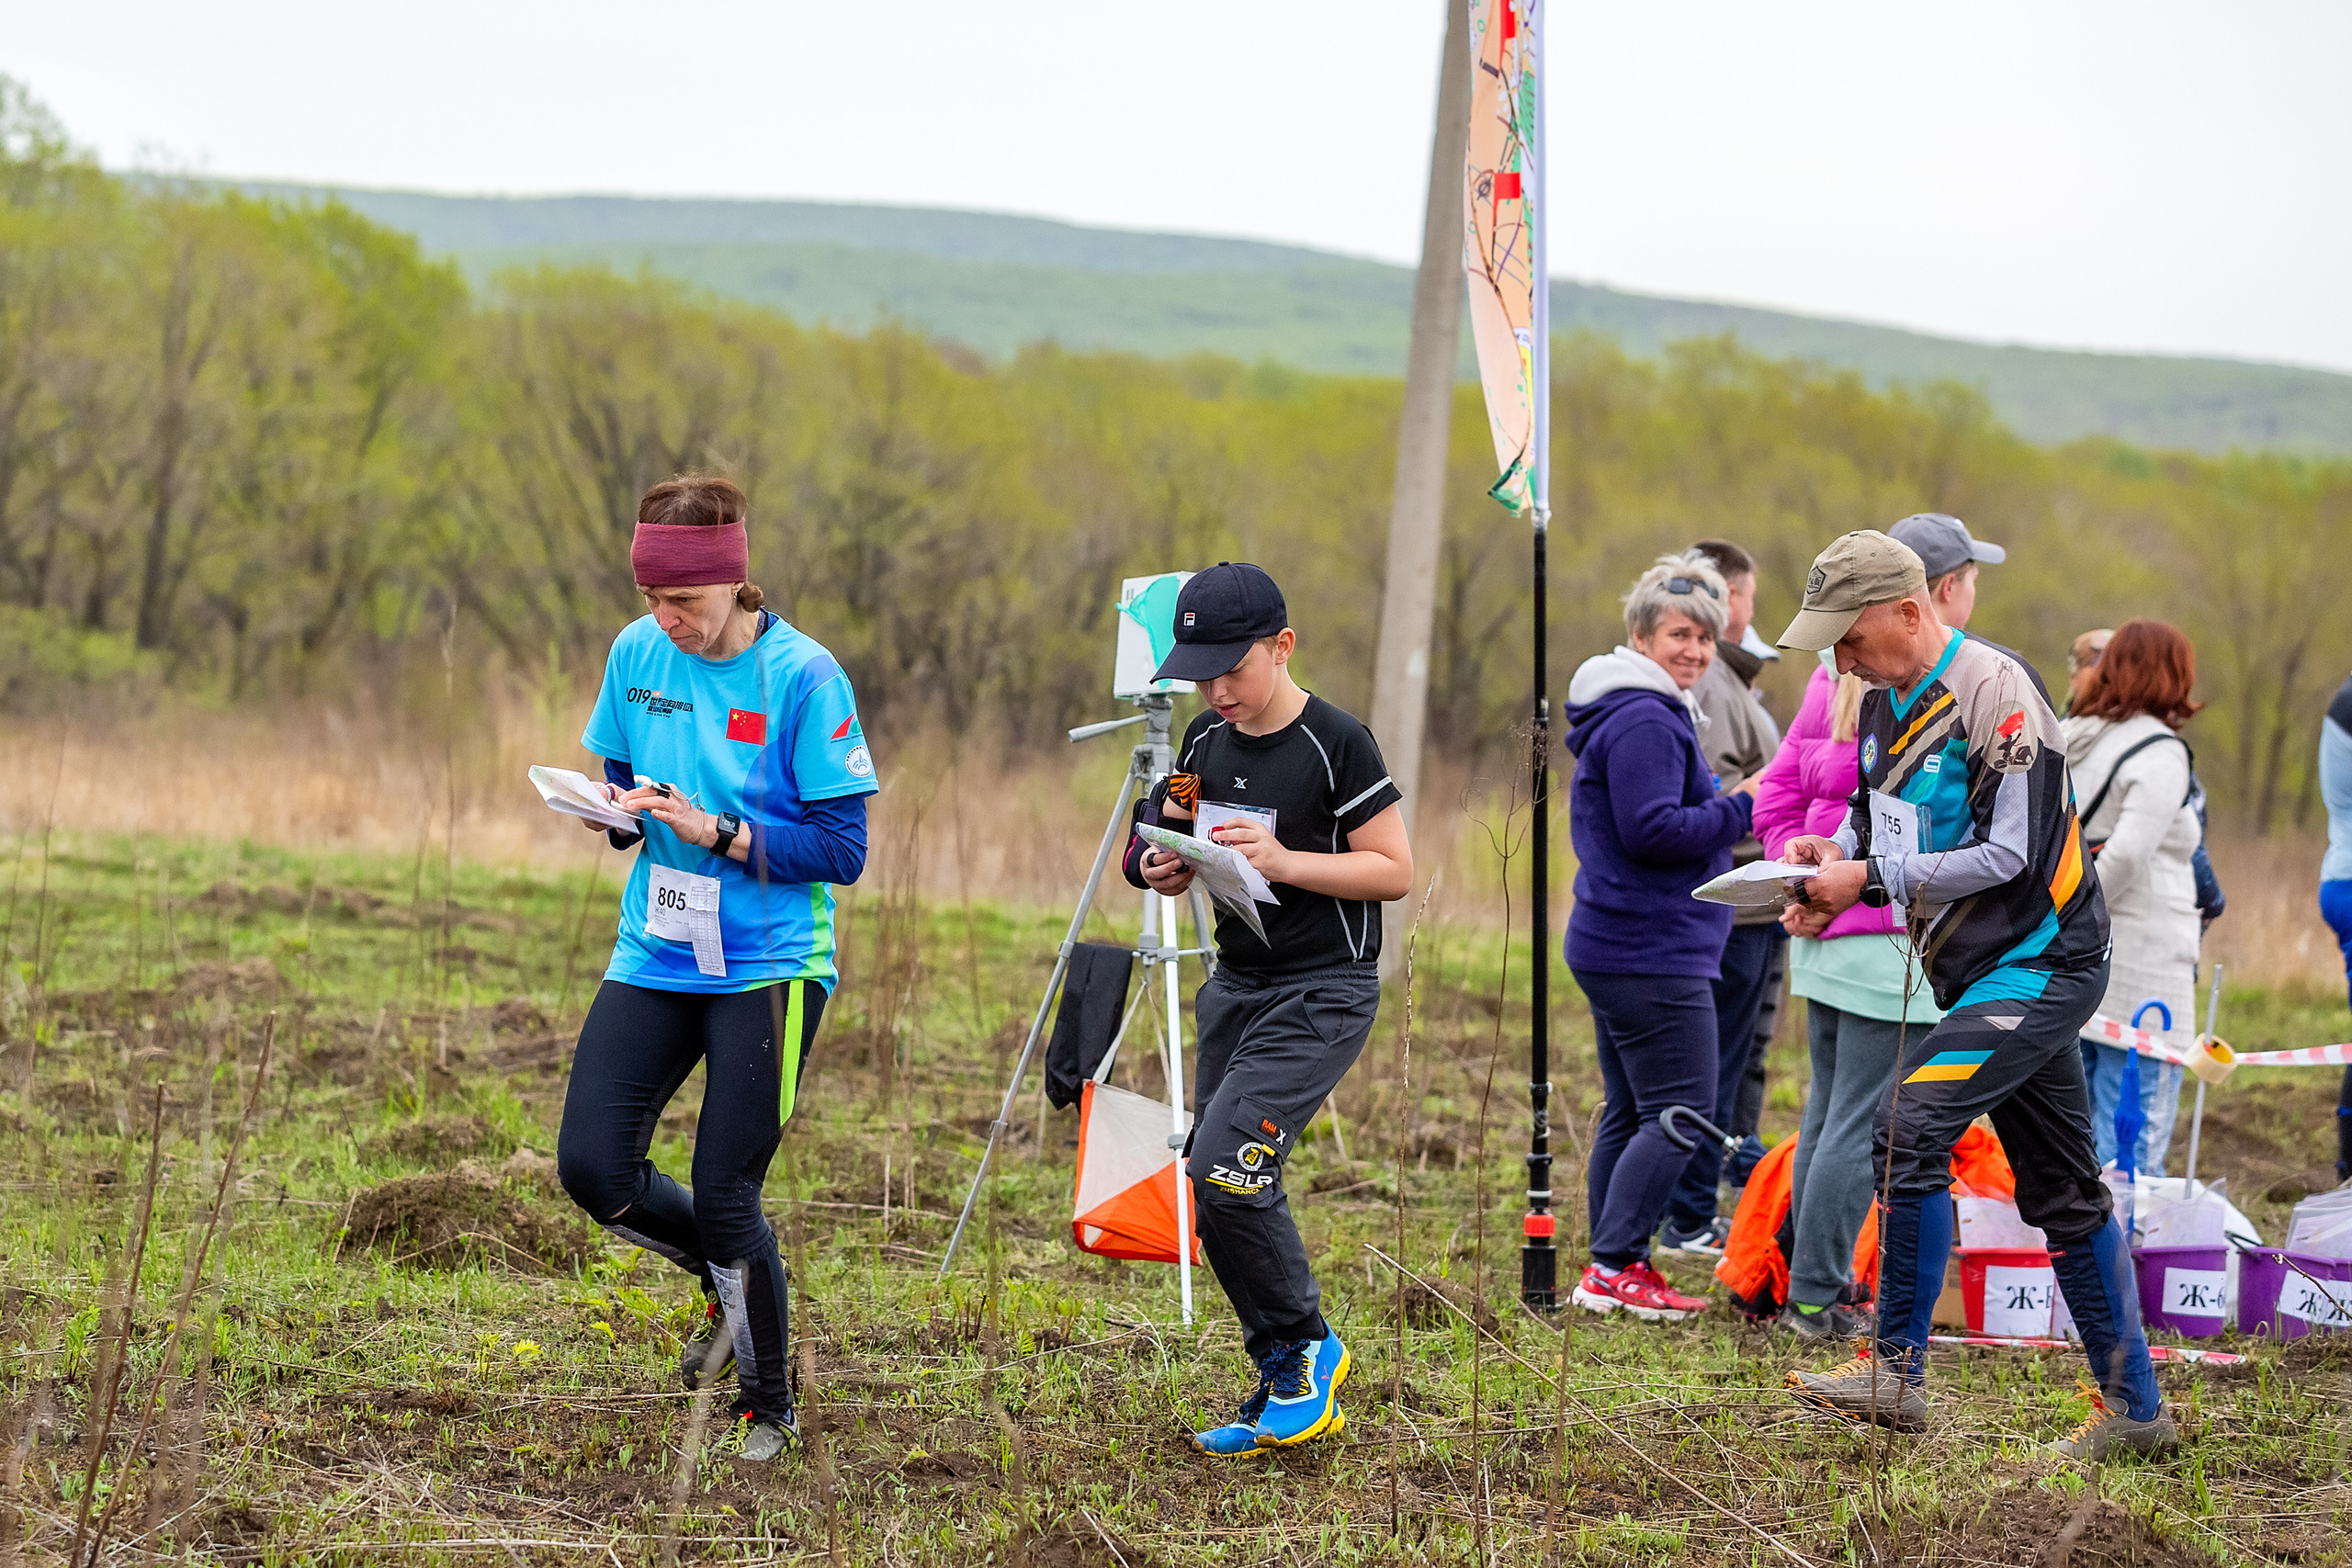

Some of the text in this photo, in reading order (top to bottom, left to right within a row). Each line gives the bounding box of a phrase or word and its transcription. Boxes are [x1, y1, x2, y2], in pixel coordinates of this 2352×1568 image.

[626, 687, 651, 704] 019
[1881, 812, 1902, 835] 755
[657, 886, 686, 911] 805
[1261, 1119, 1278, 1133] RAM
